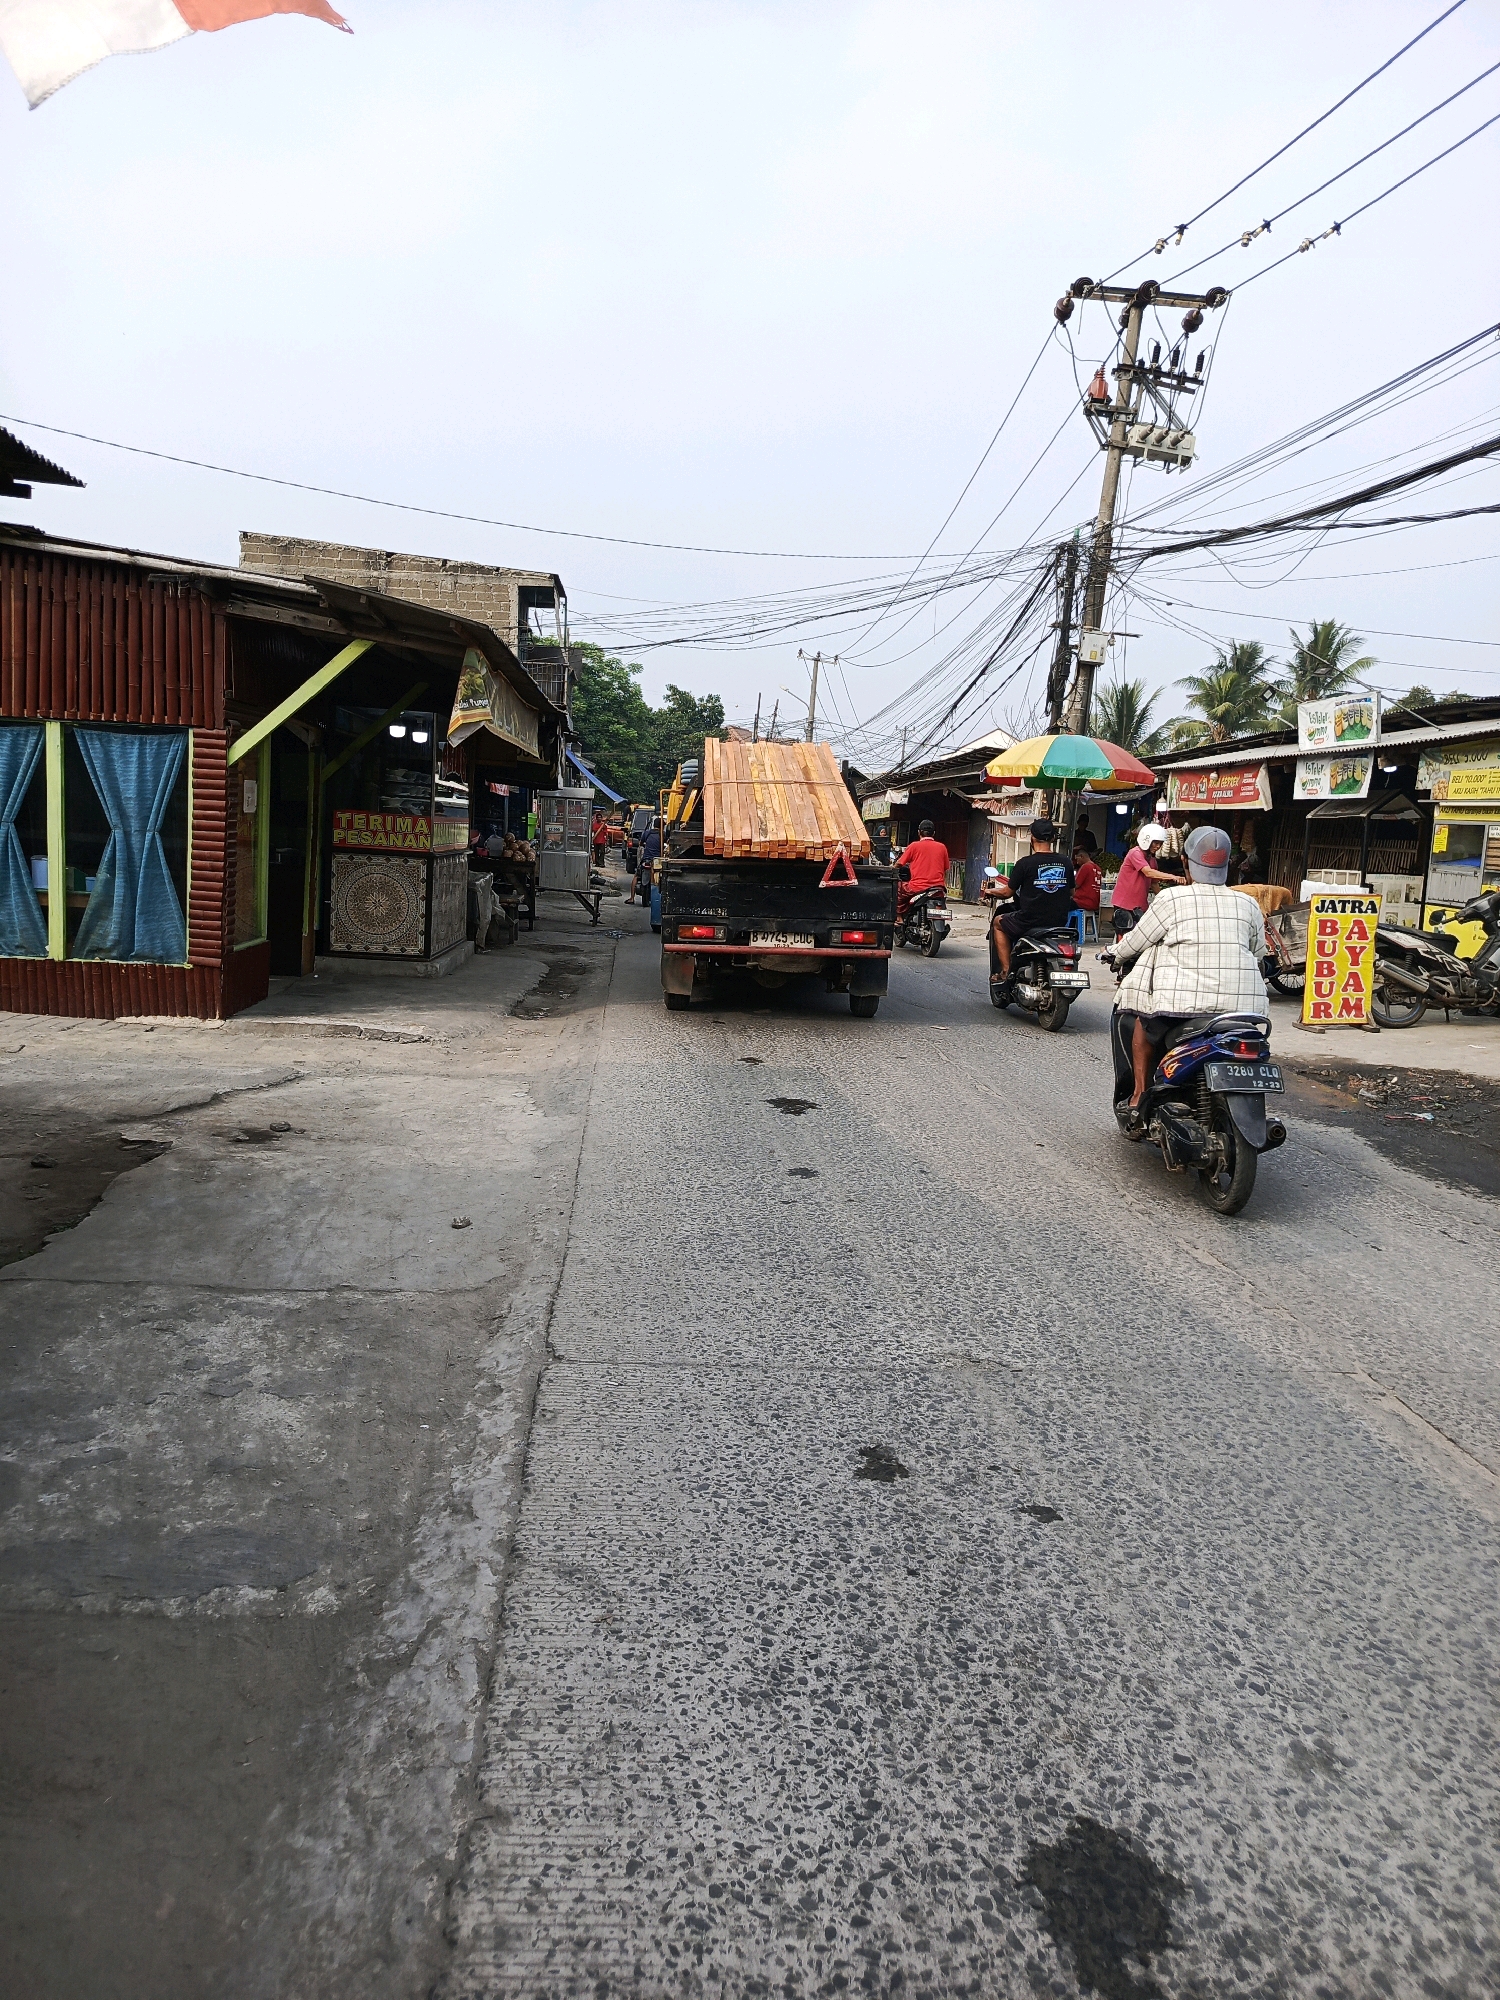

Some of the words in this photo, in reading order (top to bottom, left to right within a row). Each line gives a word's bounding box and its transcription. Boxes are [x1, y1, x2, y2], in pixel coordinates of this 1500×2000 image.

[336, 811, 431, 835] TERIMA
[333, 828, 431, 850] PESANAN
[1315, 899, 1378, 914] JATRA
[752, 931, 759, 943] B
[1310, 918, 1340, 1019] BUBUR
[1337, 918, 1370, 1019] AYAM
[1211, 1065, 1219, 1077] B
[1227, 1065, 1254, 1077] 3280
[1260, 1066, 1280, 1078] CLQ
